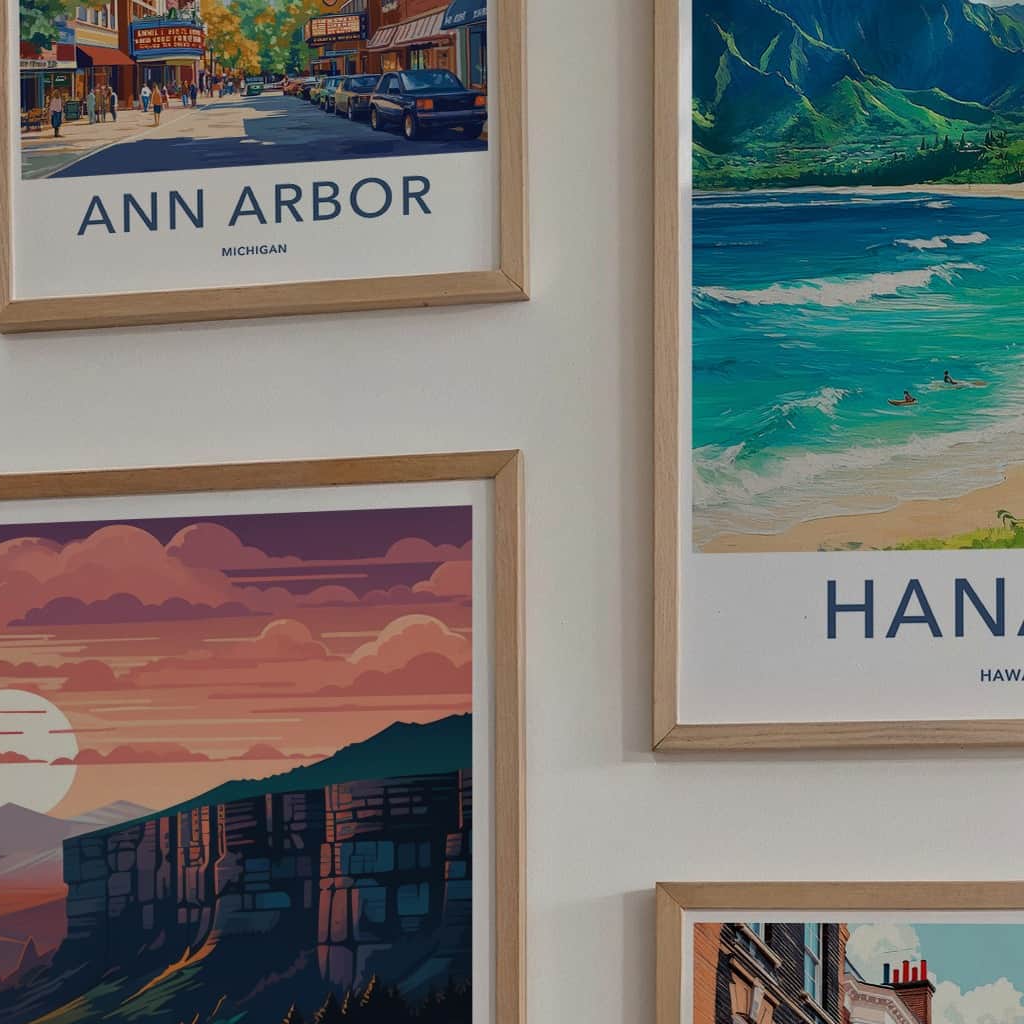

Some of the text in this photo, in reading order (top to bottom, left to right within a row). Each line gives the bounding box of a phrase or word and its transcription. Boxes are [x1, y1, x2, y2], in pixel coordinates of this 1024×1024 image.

[77, 175, 432, 236] ANN ARBOR
[221, 243, 288, 257] MICHIGAN
[826, 577, 1024, 640] HAN
[980, 668, 1024, 682] HAW
